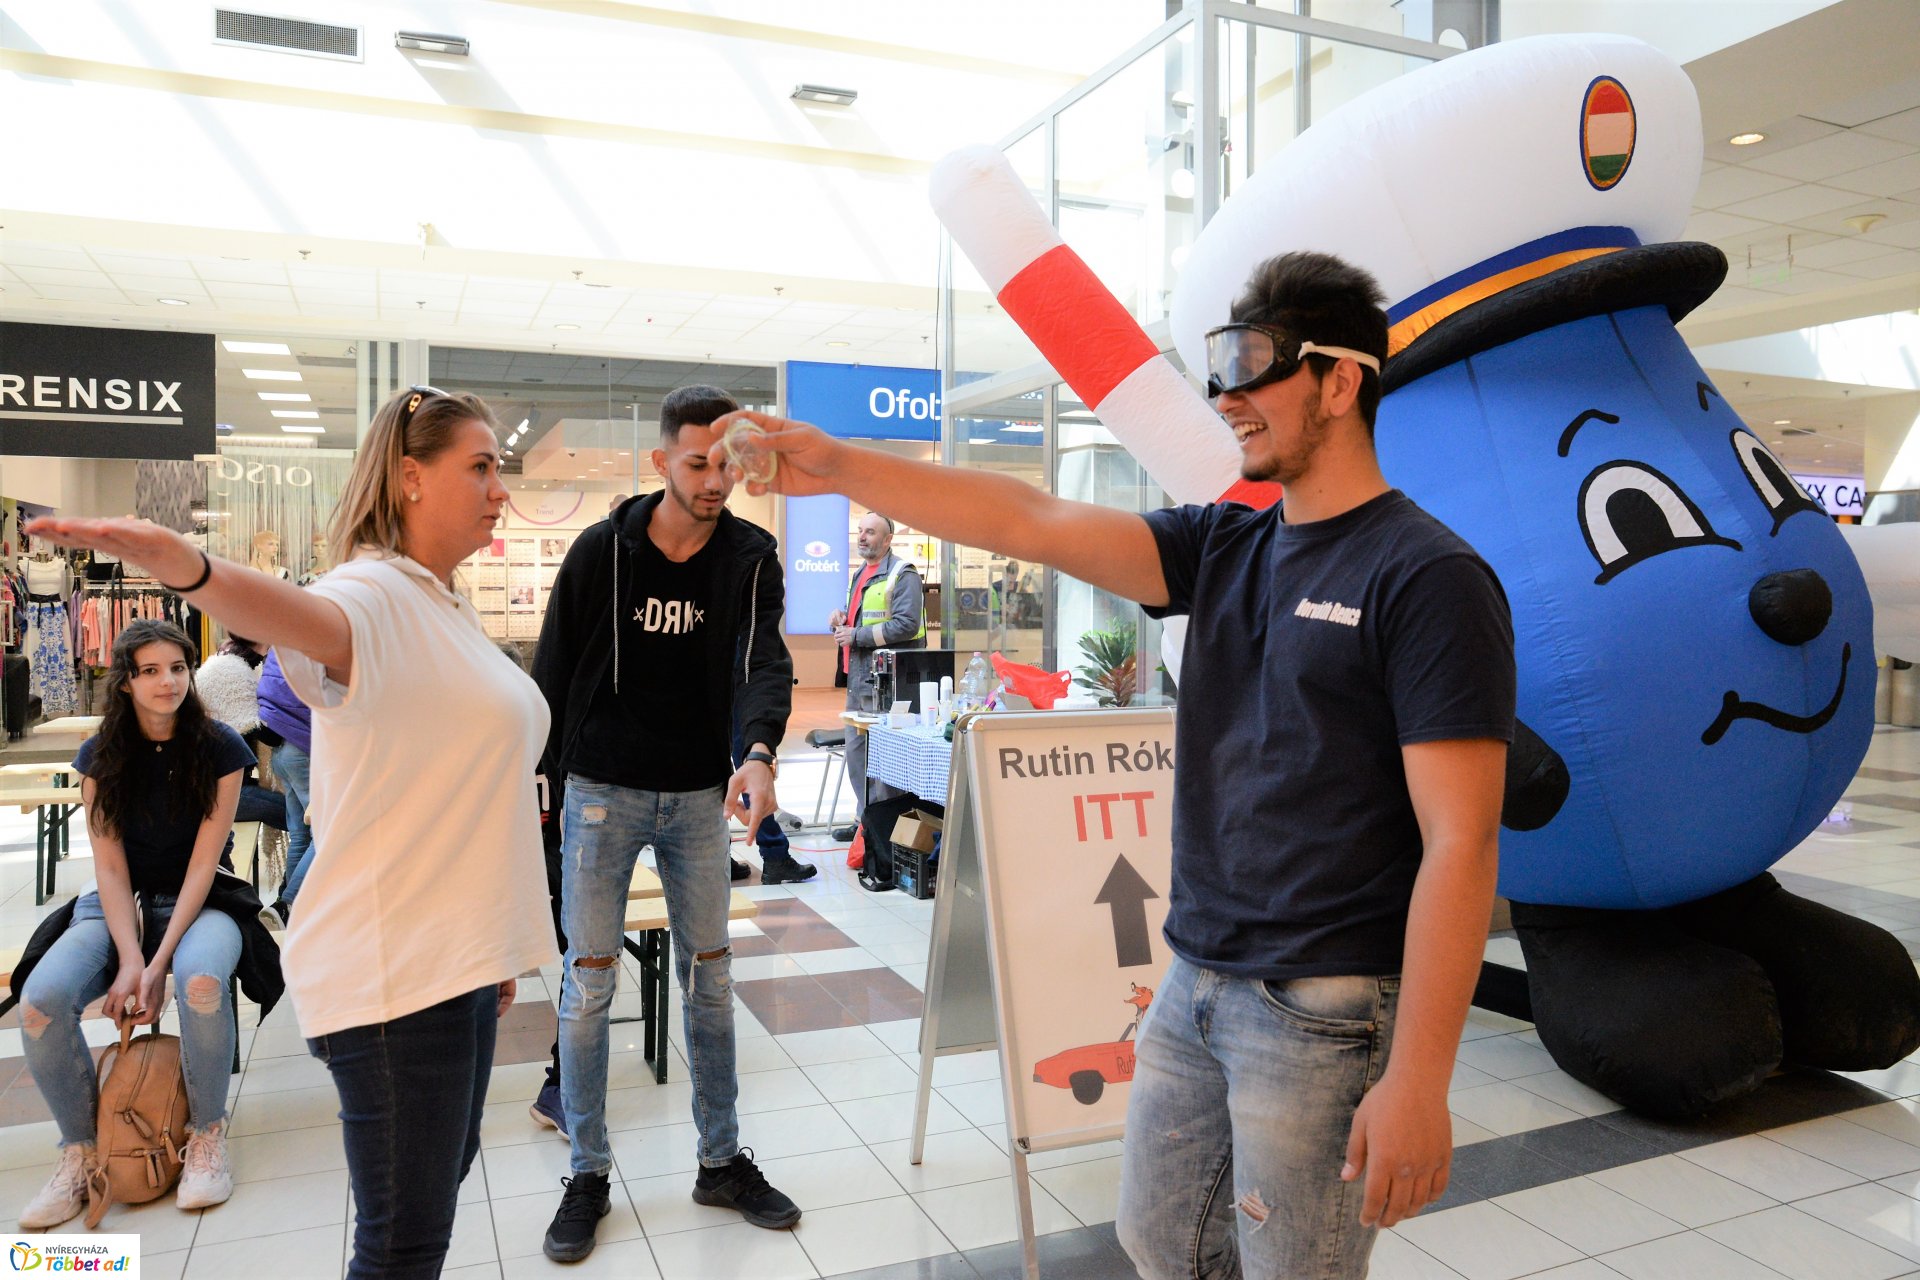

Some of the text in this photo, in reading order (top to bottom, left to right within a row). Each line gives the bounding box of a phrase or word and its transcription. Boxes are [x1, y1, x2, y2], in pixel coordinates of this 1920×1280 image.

[0, 374, 183, 413] RENSIX
[869, 387, 943, 421] Ofot
[795, 559, 840, 573] Ofotért
[998, 740, 1175, 779] Rutin Rók
[1073, 791, 1155, 842] ITT
